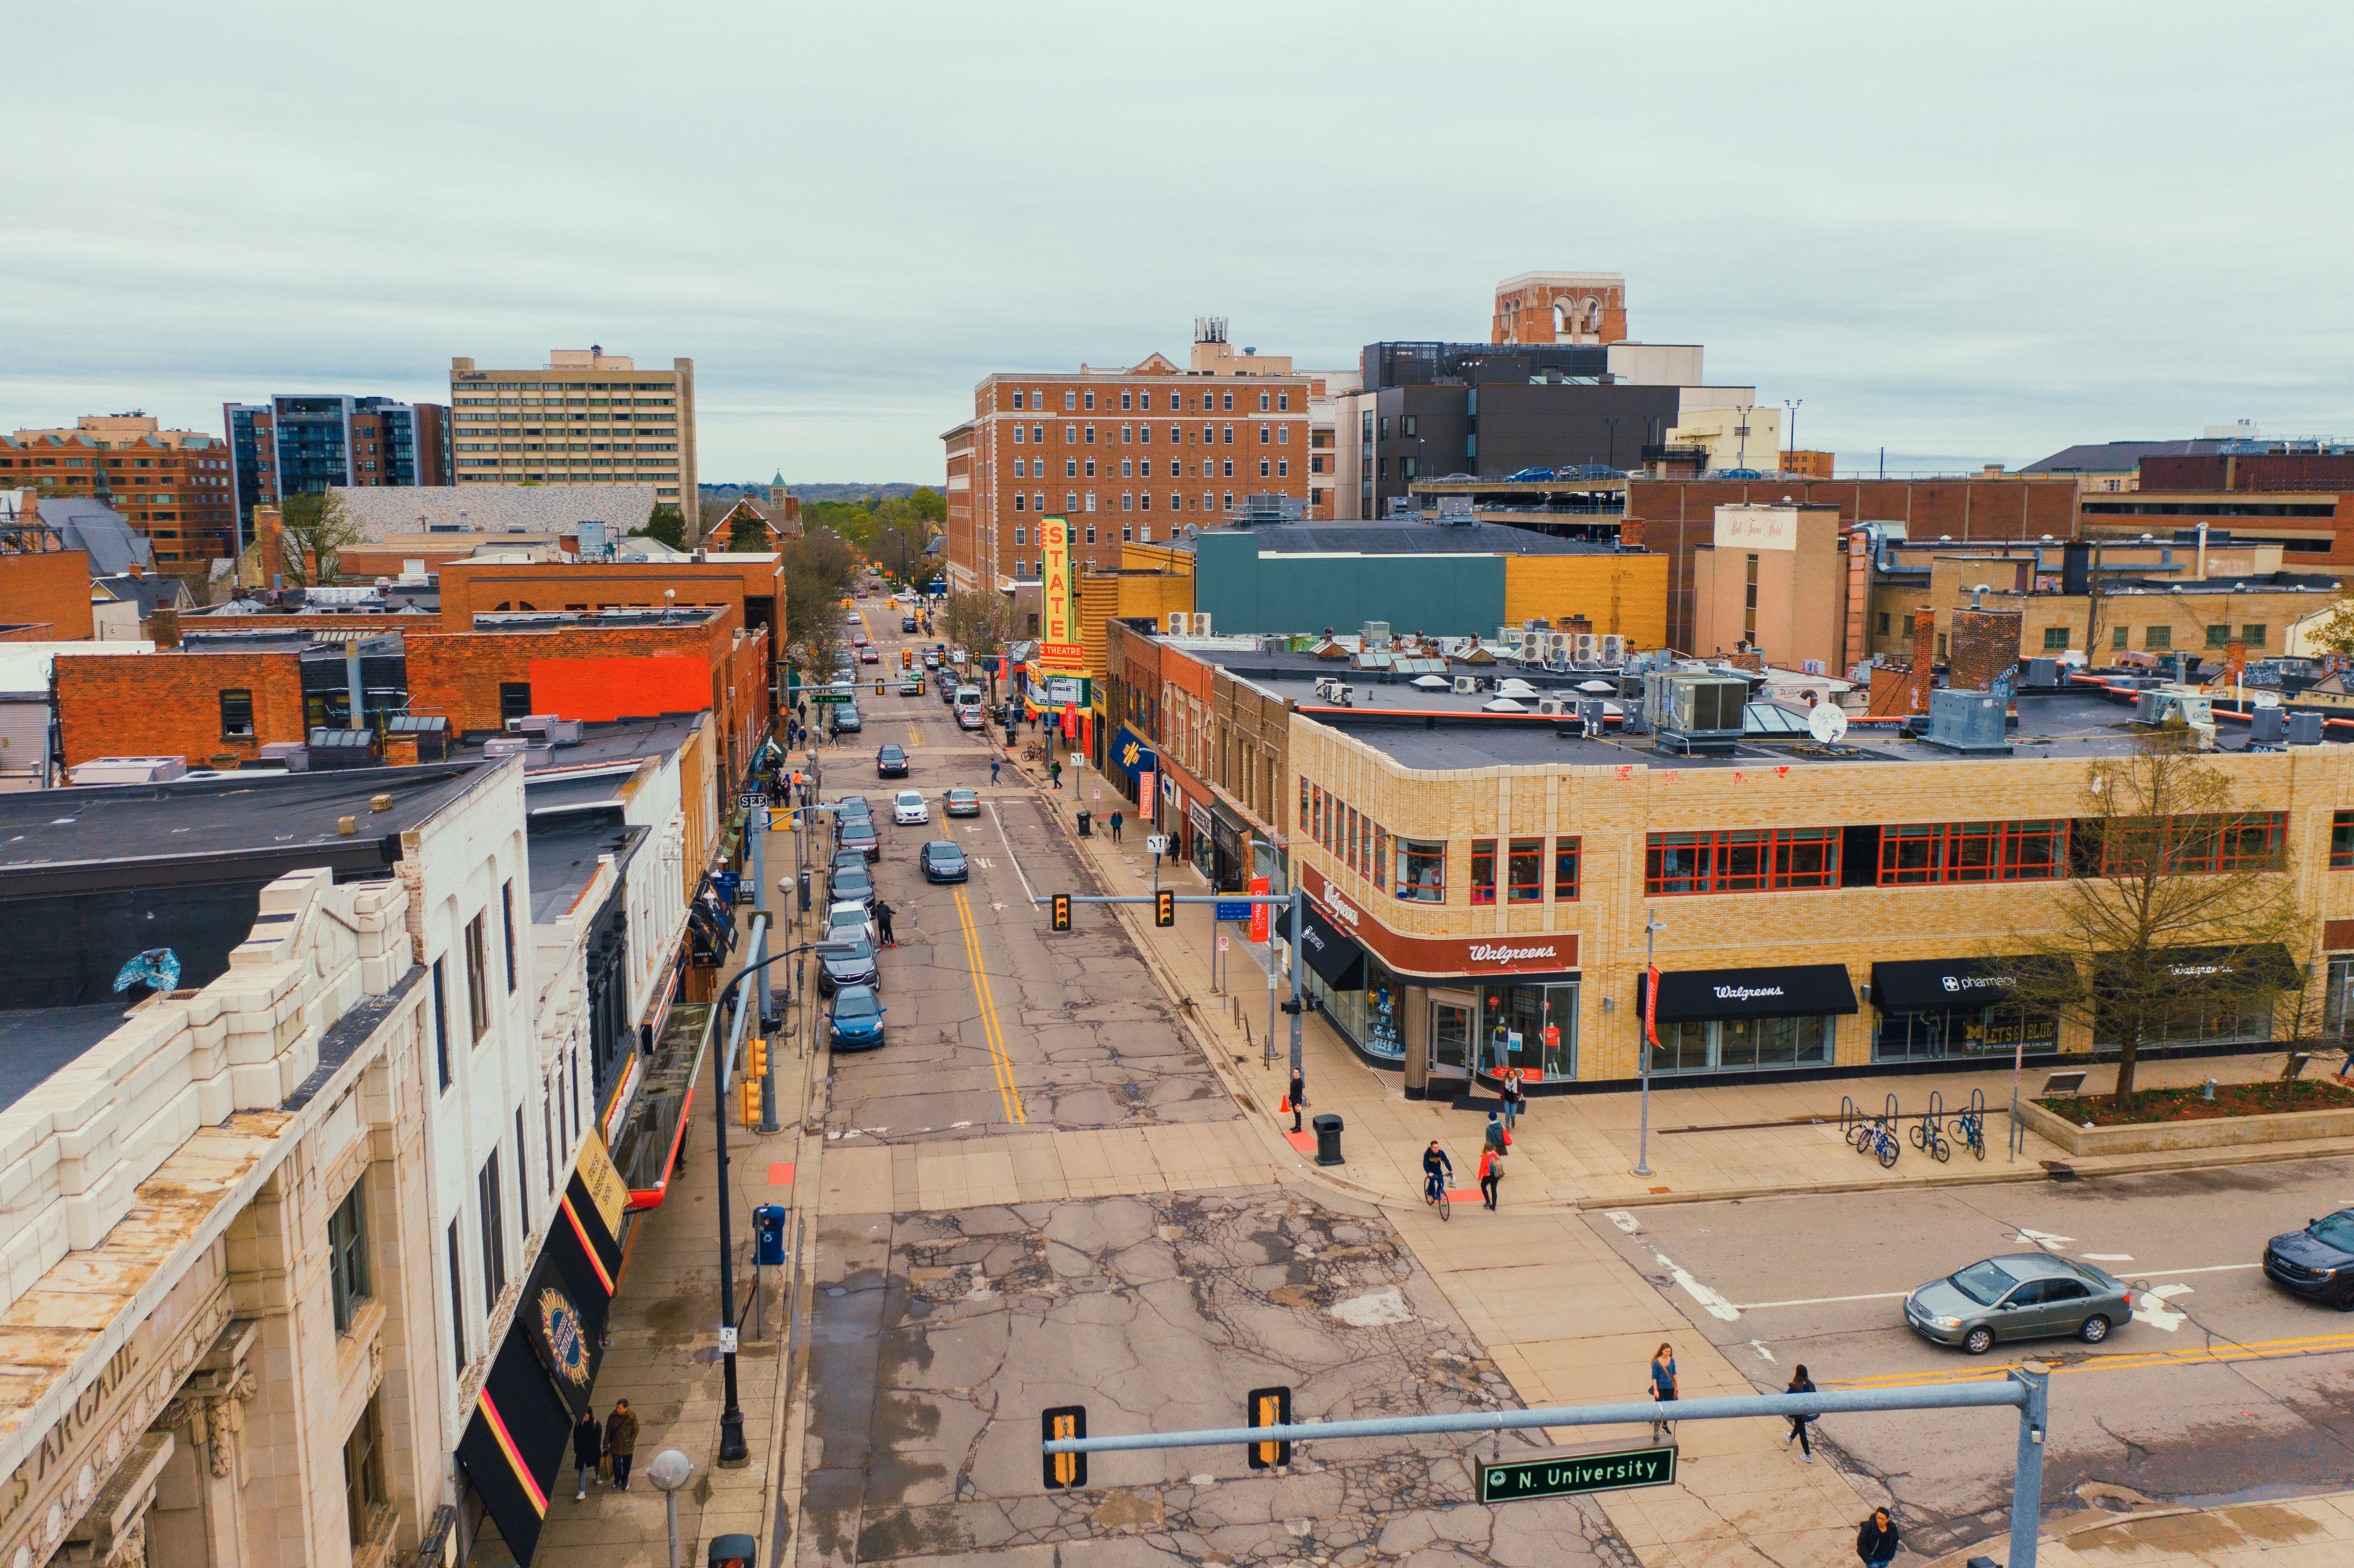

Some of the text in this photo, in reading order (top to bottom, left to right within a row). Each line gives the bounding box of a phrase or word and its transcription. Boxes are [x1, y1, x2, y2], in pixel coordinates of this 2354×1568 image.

[1727, 516, 1783, 538] Bell Tower Hotel
[1049, 527, 1064, 637] STATE
[1046, 646, 1081, 656] THEATRE
[742, 796, 765, 806] SEE
[1191, 804, 1210, 831] VERBENA
[1221, 828, 1231, 847] PIADA
[1323, 880, 1360, 927] Walgreens
[1308, 931, 1325, 951] pharmacy
[1470, 943, 1557, 964] Walgreens
[1713, 985, 1784, 1001] Walgreens
[1960, 975, 2017, 991] pharmacy
[1984, 1026, 2012, 1044] LET'S
[2027, 1021, 2053, 1040] BLUE
[592, 1159, 609, 1202] UNDERGROUND
[603, 1183, 612, 1205] SHOPS
[554, 1314, 568, 1344] ESPRESSO
[560, 1321, 575, 1360] ROYALE
[1519, 1460, 1657, 1489] N. University
